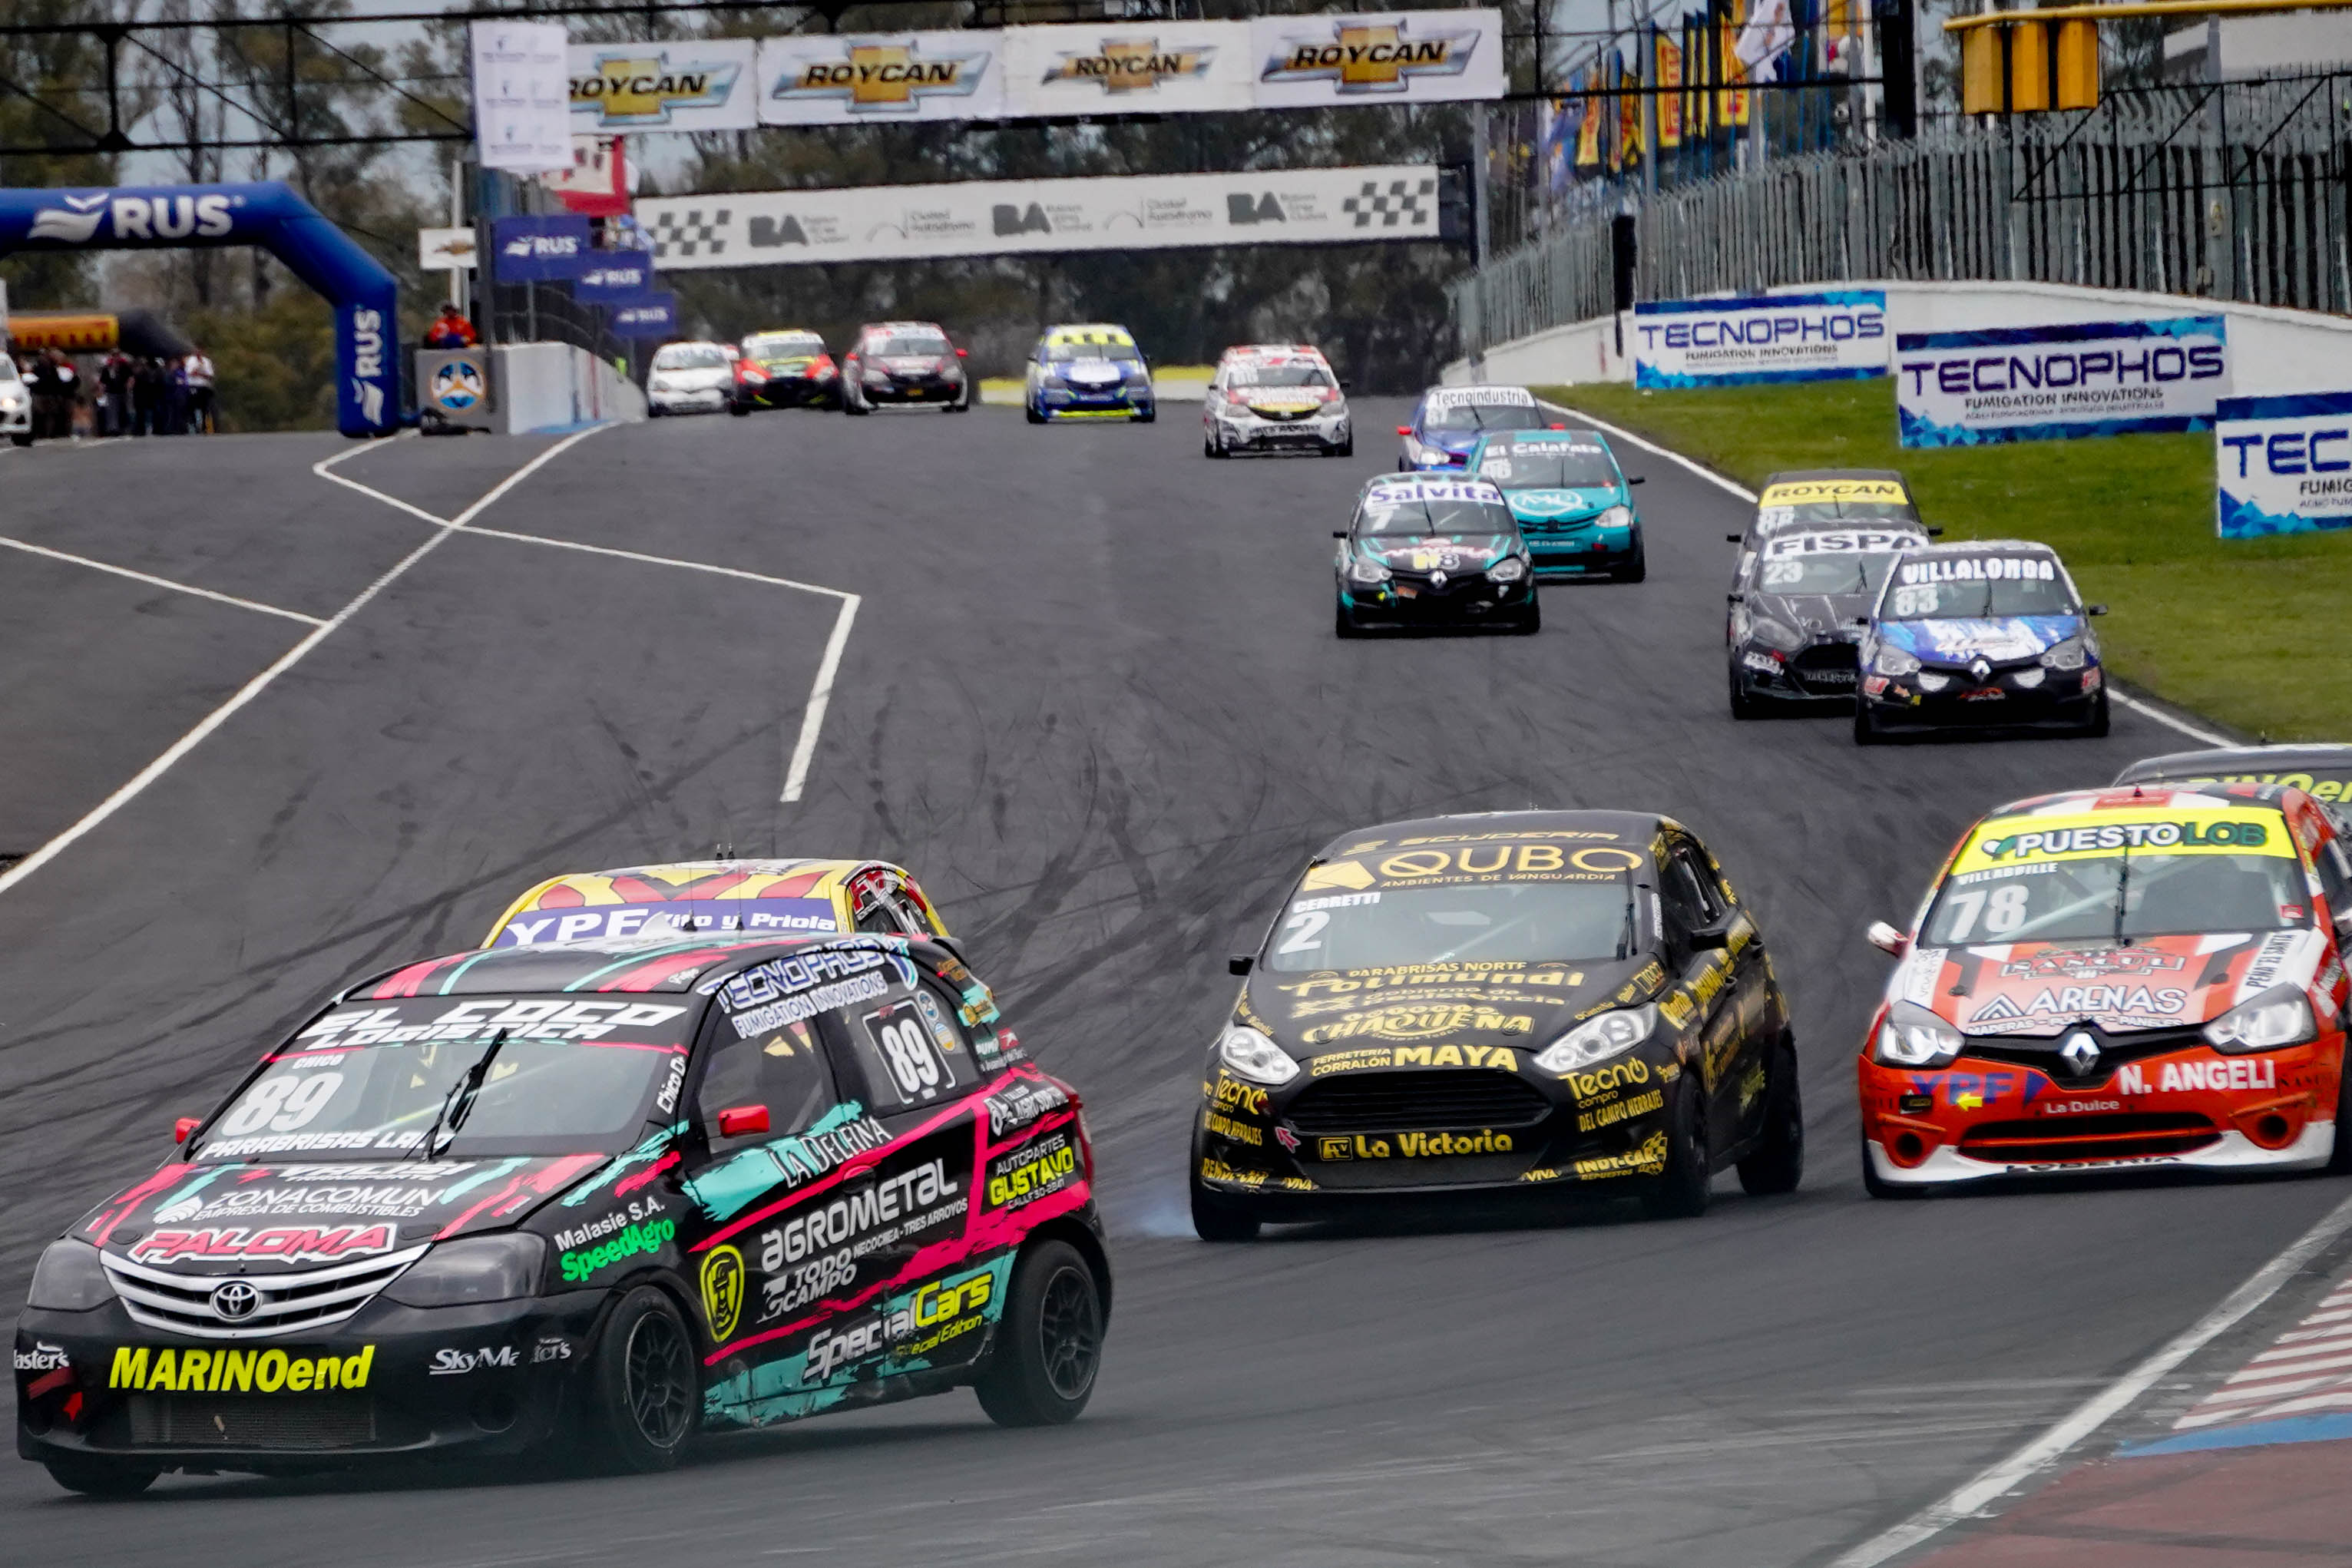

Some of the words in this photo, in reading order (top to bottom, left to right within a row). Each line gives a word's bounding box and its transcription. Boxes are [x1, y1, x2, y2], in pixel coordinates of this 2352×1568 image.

[1074, 53, 1183, 77] ROYCAN
[1295, 42, 1445, 68] ROYCAN
[806, 62, 955, 86] ROYCAN
[111, 194, 233, 238] RUS
[534, 236, 578, 255] RUS
[605, 269, 642, 286] RUS
[355, 309, 382, 378] RUS
[1639, 312, 1884, 349] TECNOPHOS
[1902, 344, 2225, 396] TECNOPHOS
[1435, 390, 1528, 405] Tecnoindustria
[1965, 392, 2056, 409] FUMIGATION
[2062, 386, 2164, 404] INNOVATIONS
[1485, 444, 1506, 458] El
[1512, 440, 1603, 455] Calafate
[2222, 428, 2351, 478] TEC
[1371, 484, 1500, 503] Salvita
[1771, 485, 1897, 499] ROYCAN
[1773, 534, 1918, 555] FISPA
[1764, 561, 1804, 585] 23
[1895, 587, 1939, 617] 83
[1380, 845, 1643, 878] QUBO
[1381, 873, 1474, 888] AMBIENTES
[1480, 874, 1502, 882] DE
[1509, 872, 1617, 882] VANGUARDIA
[1292, 891, 1381, 913] CERRETTI
[1947, 885, 2029, 944] 78
[506, 908, 649, 946] YPF
[750, 912, 836, 931] Priola
[1277, 911, 1332, 955] 2
[1348, 963, 1459, 978] PARABRISAS
[732, 992, 816, 1040] FUMIGATION
[809, 971, 889, 1014] INNOVATIONS
[2024, 984, 2188, 1014] ARENAS
[297, 1007, 402, 1039] EL
[433, 999, 688, 1027] COCO
[1967, 1018, 2036, 1036] MADERAS
[2119, 1015, 2184, 1028] PANELES
[305, 1022, 618, 1050] LOGISTICA
[292, 1054, 346, 1070] CHICO
[881, 1018, 940, 1093] 89
[1312, 1047, 1391, 1066] FERRETERIA
[1393, 1044, 1519, 1072] MAYA
[1312, 1056, 1391, 1077] CORRALÓN
[1556, 1056, 1650, 1101] Tecno
[1910, 1072, 2015, 1105] YPF
[2119, 1064, 2153, 1095] N.
[2160, 1060, 2276, 1093] ANGELI
[221, 1071, 344, 1136] 89
[1578, 1090, 1619, 1110] compro
[1578, 1112, 1596, 1133] DEL
[1596, 1103, 1628, 1128] CAMPO
[1627, 1089, 1665, 1119] HERRAJES
[2043, 1102, 2067, 1114] La
[2069, 1100, 2120, 1113] Dulce
[196, 1131, 376, 1162] PARABRISAS
[769, 1151, 813, 1189] LA
[799, 1115, 894, 1174] DELFINA
[996, 1133, 1066, 1176] AUTOPARTES
[1356, 1135, 1391, 1159] La
[1397, 1128, 1513, 1158] Victoria
[989, 1145, 1075, 1207] GUSTAVO
[1283, 1177, 1313, 1191] VIVA
[1524, 1168, 1559, 1183] VIVA
[1581, 1169, 1634, 1181] REPUESTOS
[192, 1204, 268, 1222] EMPRESA
[271, 1203, 296, 1215] DE
[298, 1202, 425, 1218] COMBUSTIBLES
[554, 1209, 629, 1252] Malasie
[627, 1196, 667, 1222] S.A.
[904, 1215, 928, 1237] TRES
[926, 1198, 969, 1229] ARROYOS
[131, 1223, 395, 1262] PALOMA
[560, 1217, 676, 1282] SpeedAgro
[793, 1248, 852, 1286] TODO
[782, 1263, 858, 1314] CAMPO
[939, 1314, 983, 1343] Edition
[109, 1345, 376, 1392] MARINOend
